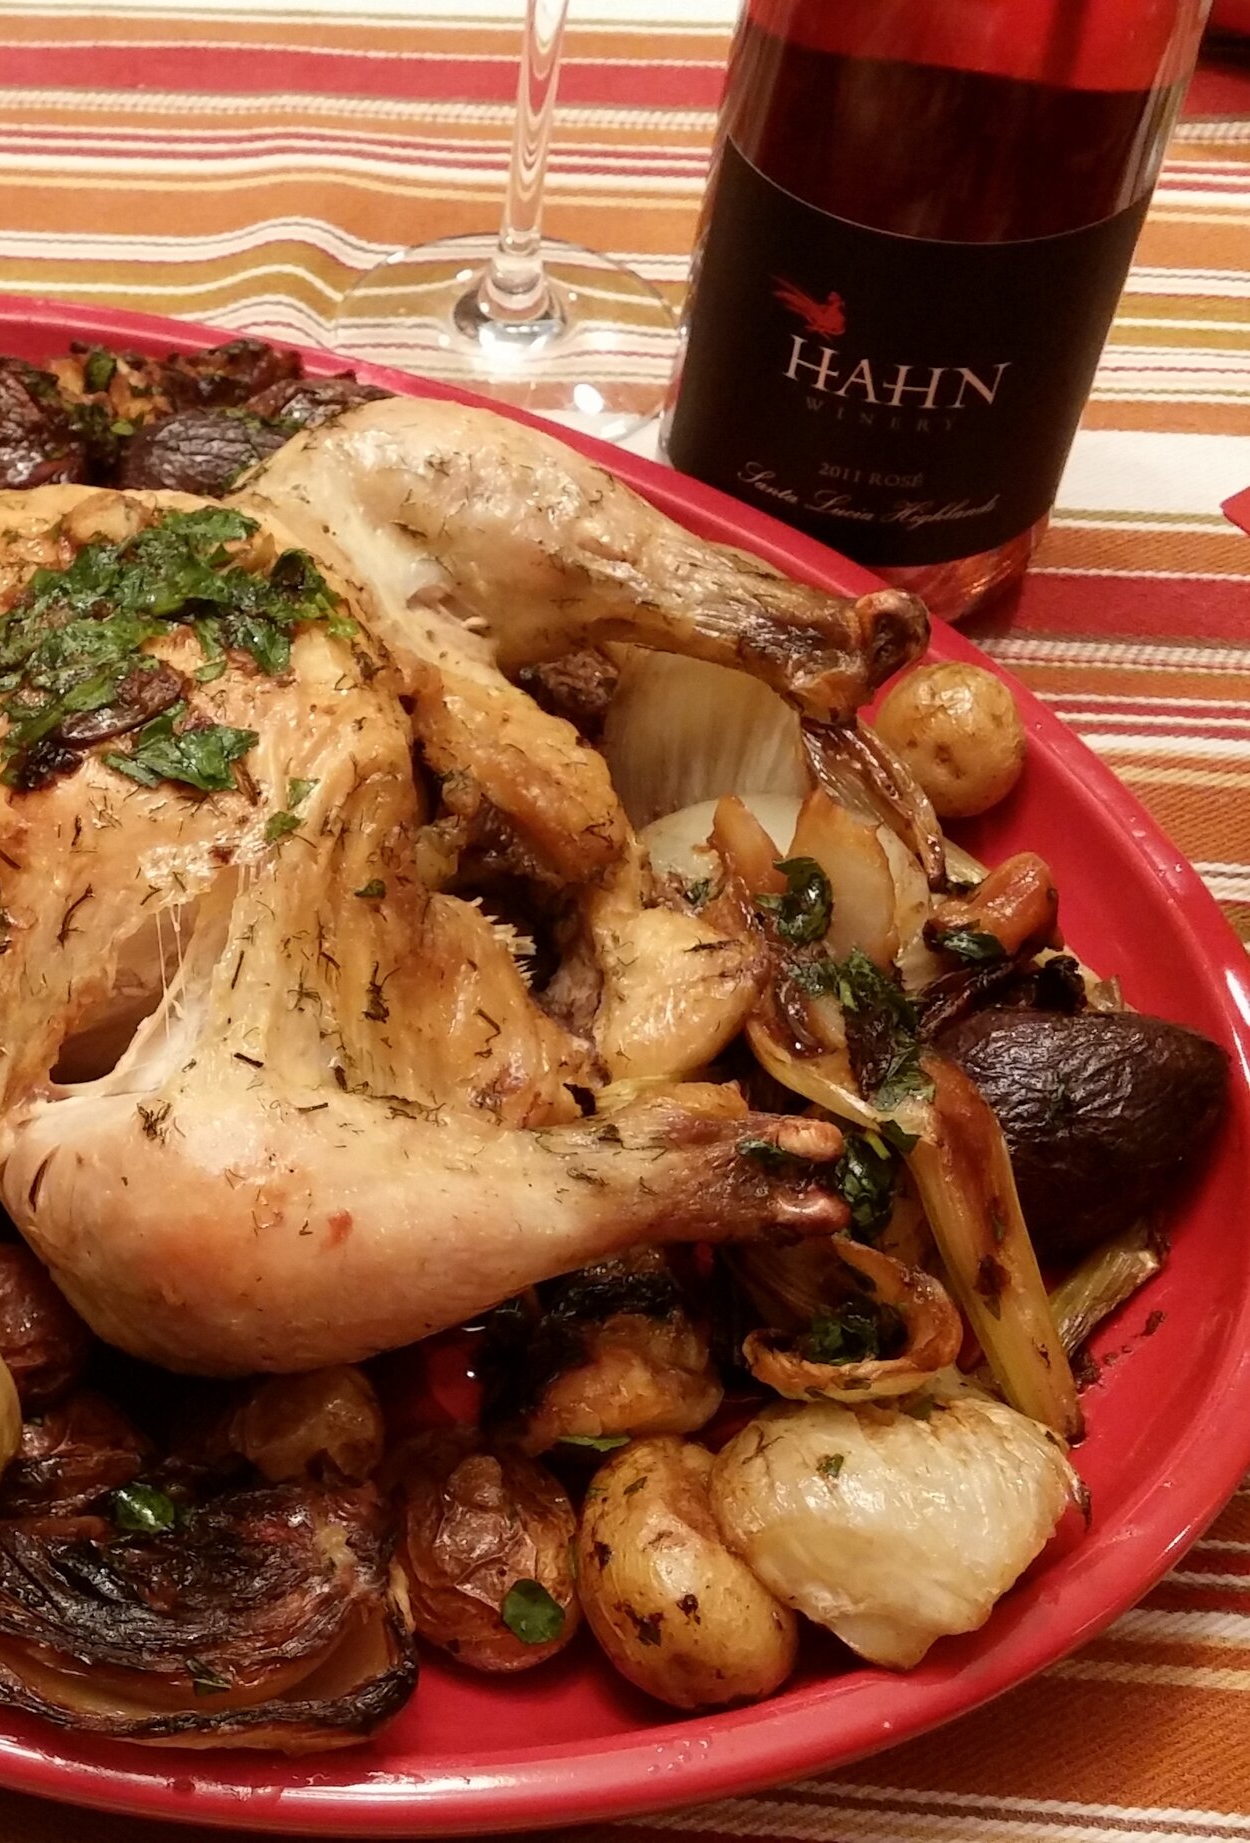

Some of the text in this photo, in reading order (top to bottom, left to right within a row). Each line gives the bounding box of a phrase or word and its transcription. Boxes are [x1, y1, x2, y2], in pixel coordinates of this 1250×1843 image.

[783, 334, 1012, 410] HAHN
[805, 397, 956, 432] WINERY
[737, 462, 1000, 529] Santa Lucia Highlands
[818, 463, 861, 483] 2011
